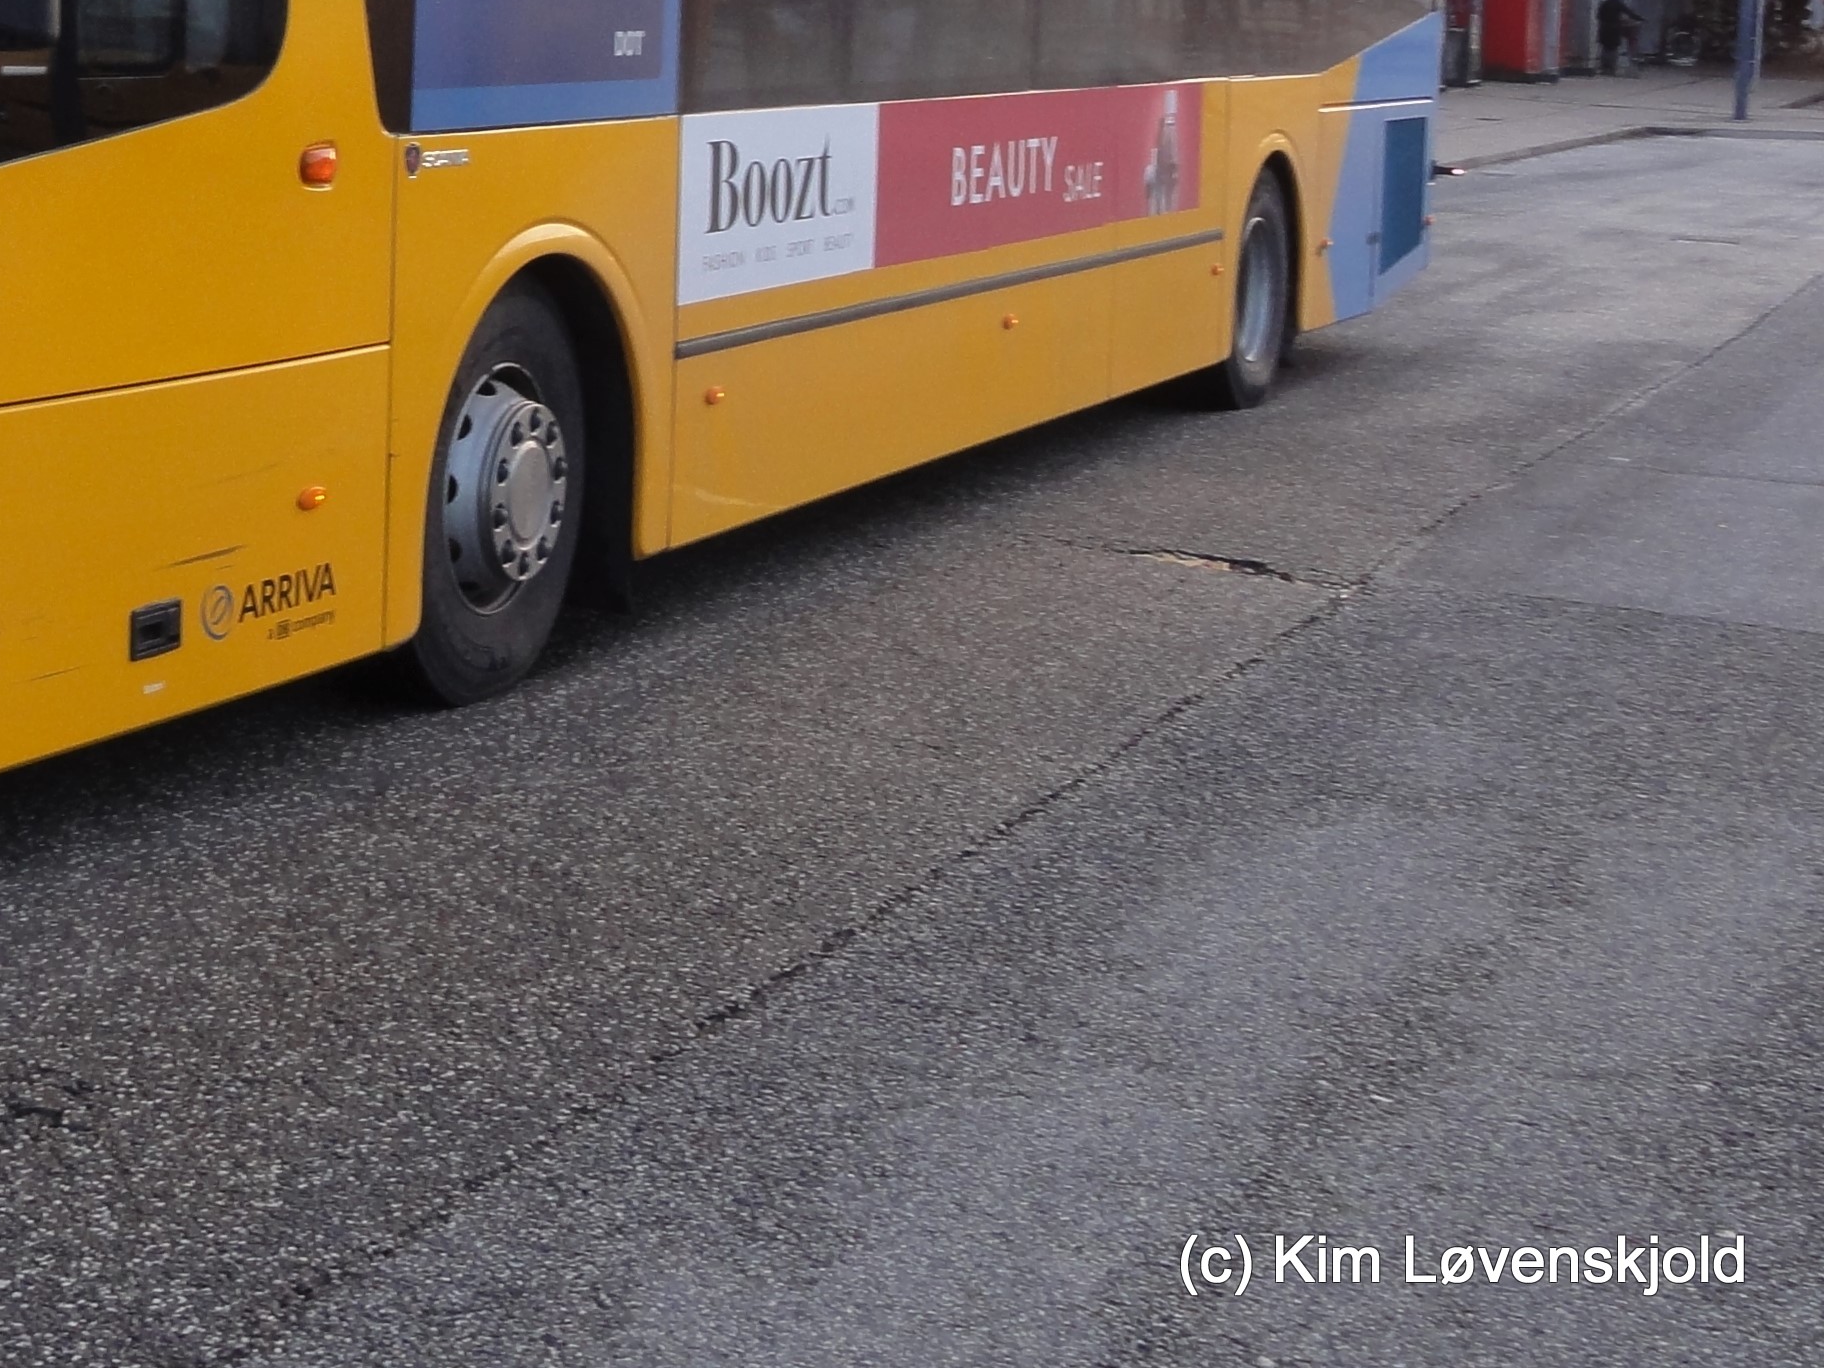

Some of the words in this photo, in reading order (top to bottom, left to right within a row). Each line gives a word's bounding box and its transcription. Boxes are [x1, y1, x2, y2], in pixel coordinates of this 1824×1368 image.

[951, 136, 1058, 207] BEAUTY
[1063, 161, 1104, 203] SALE
[238, 562, 336, 623] ARRIVA
